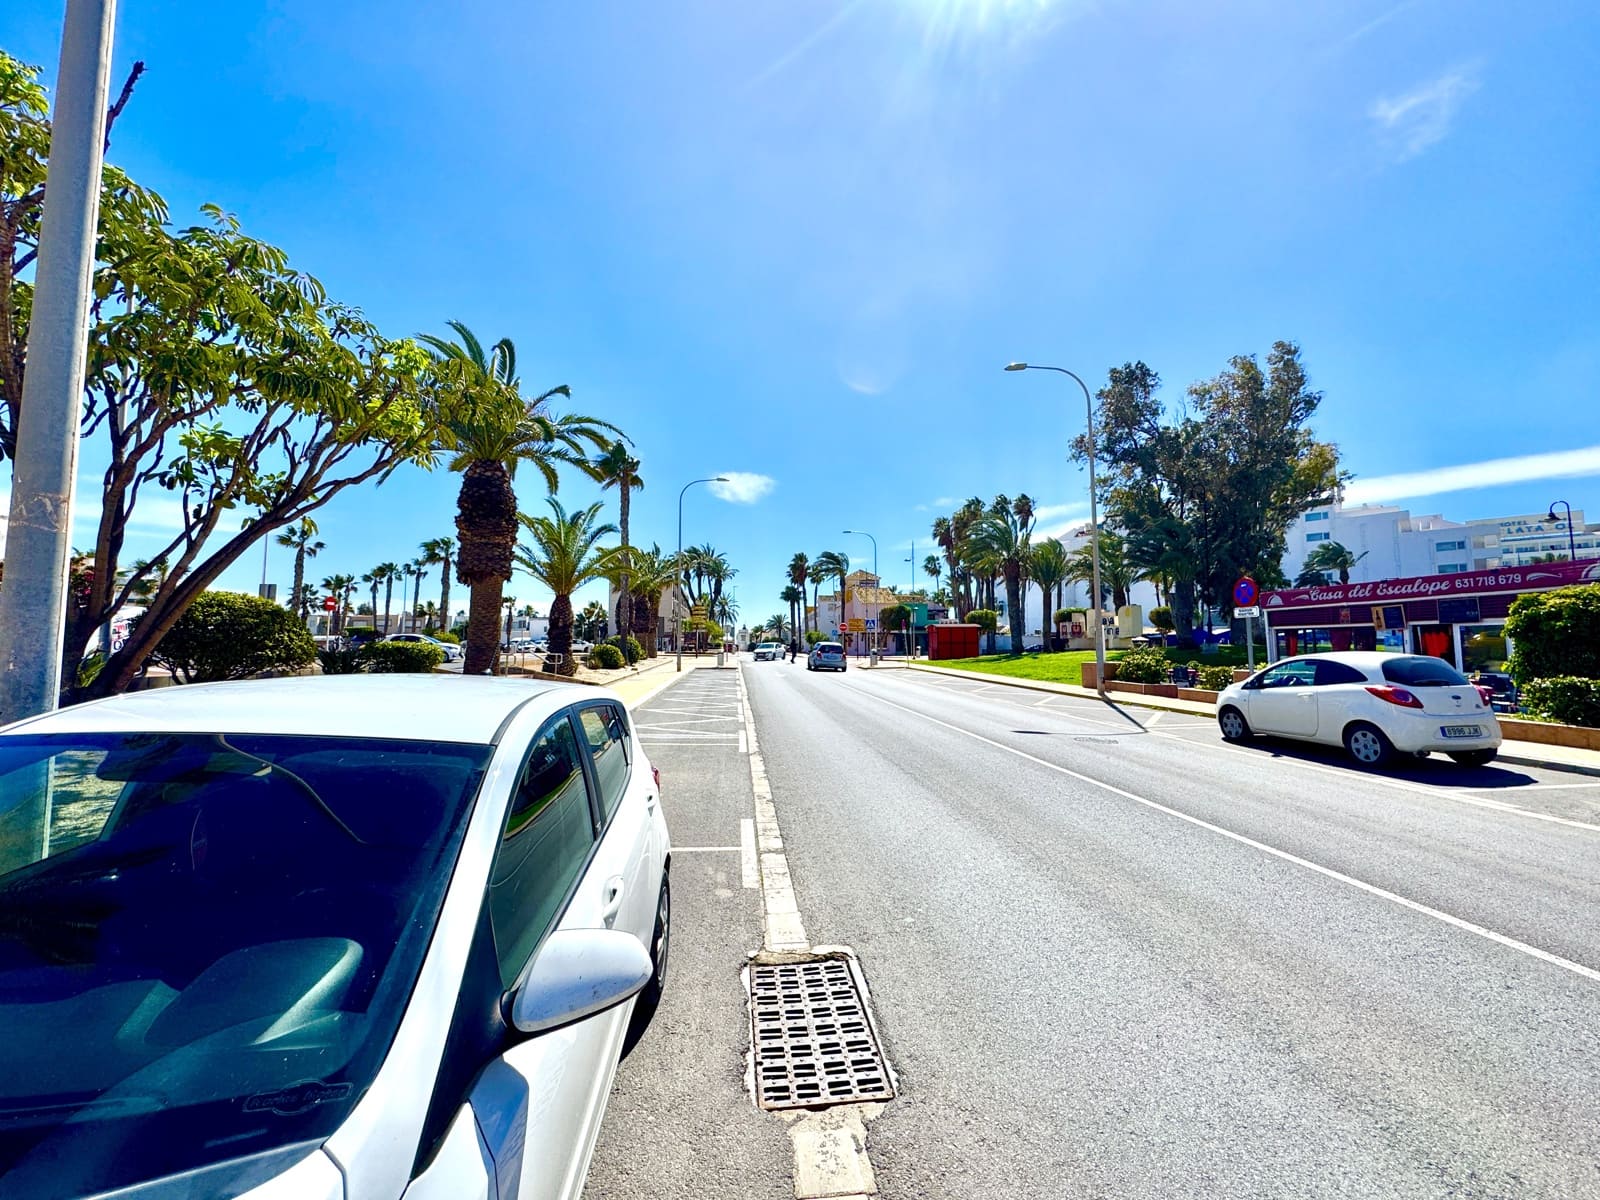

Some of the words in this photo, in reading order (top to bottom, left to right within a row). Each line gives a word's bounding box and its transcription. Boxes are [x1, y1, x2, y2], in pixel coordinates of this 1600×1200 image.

[1309, 587, 1345, 601] Casa
[1348, 584, 1373, 598] del
[1376, 578, 1451, 597] Escalope
[1455, 578, 1474, 589] 631
[1477, 575, 1496, 587] 718
[1498, 573, 1522, 585] 679
